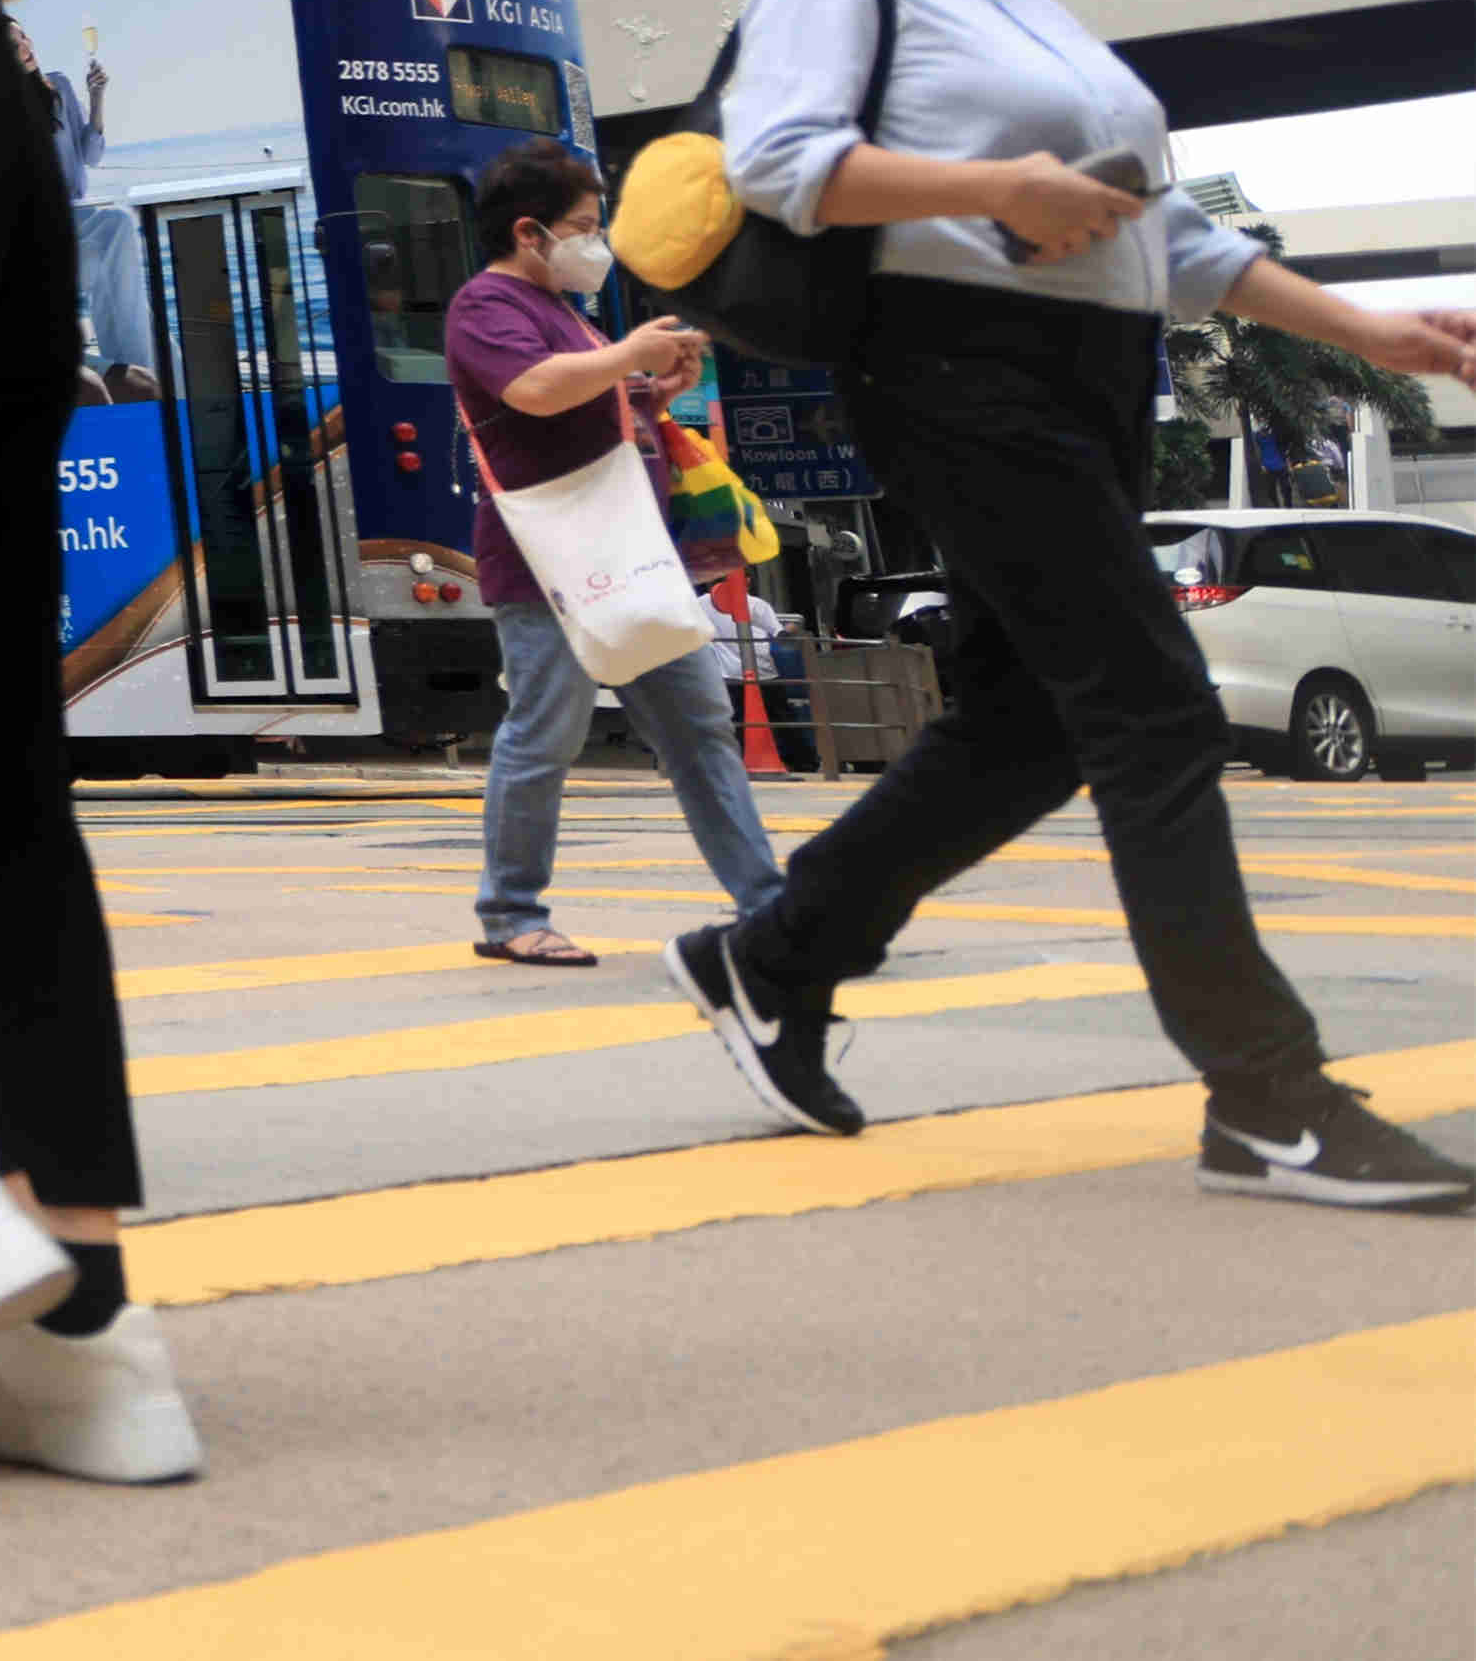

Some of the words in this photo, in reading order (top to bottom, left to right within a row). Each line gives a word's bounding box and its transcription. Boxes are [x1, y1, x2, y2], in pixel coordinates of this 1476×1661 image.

[530, 6, 564, 35] ASIA
[338, 60, 390, 81] 2878
[392, 61, 440, 83] 5555
[341, 95, 446, 119] KGI.com.hk
[741, 445, 819, 460] Kowloon
[58, 457, 119, 492] 555
